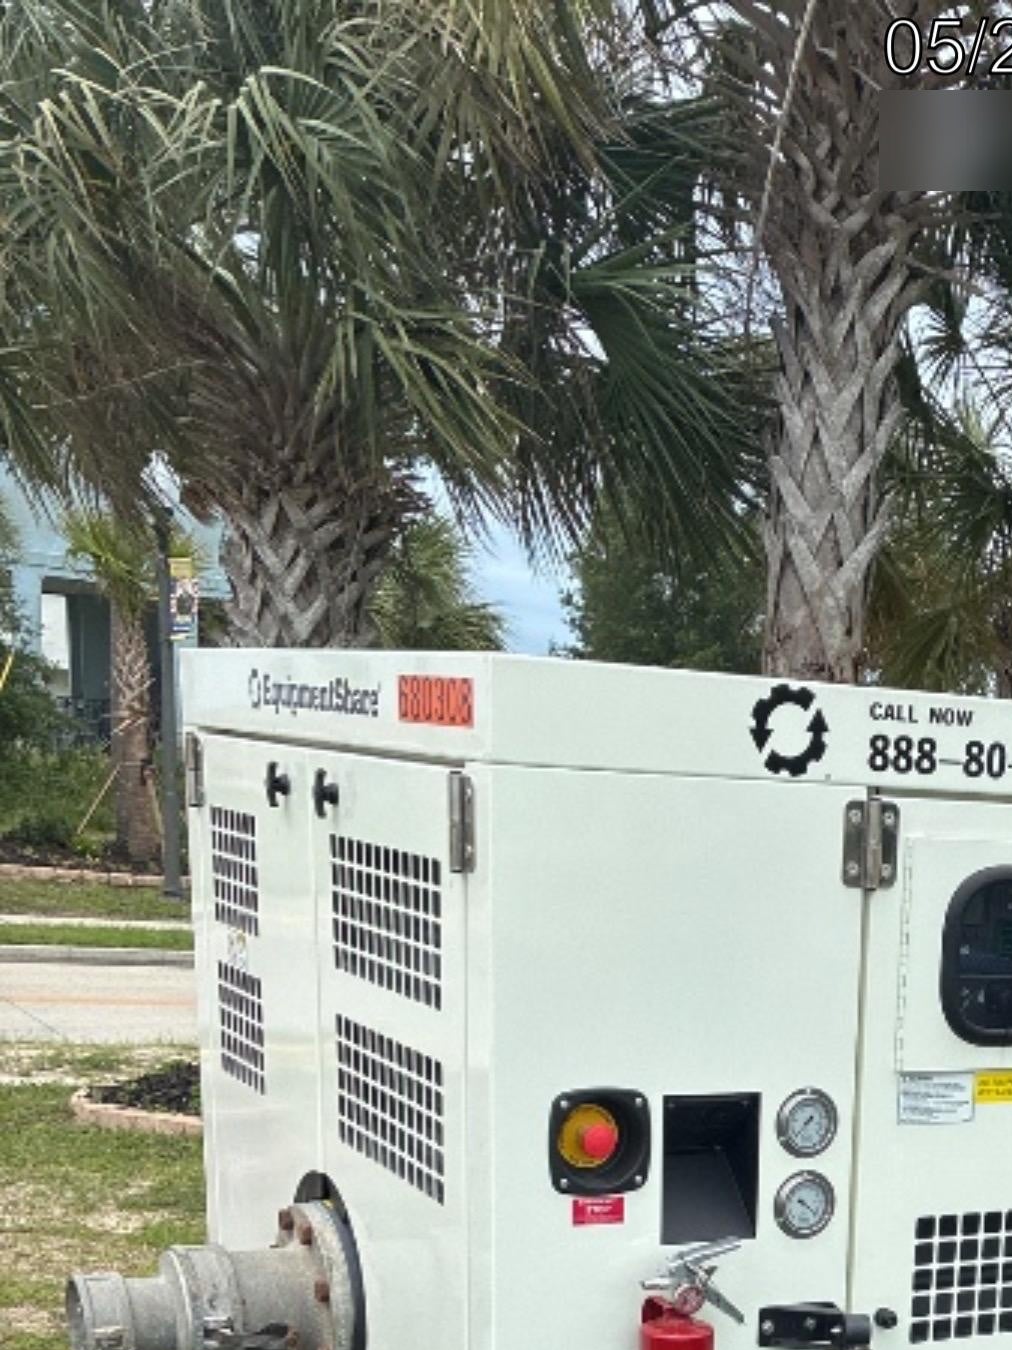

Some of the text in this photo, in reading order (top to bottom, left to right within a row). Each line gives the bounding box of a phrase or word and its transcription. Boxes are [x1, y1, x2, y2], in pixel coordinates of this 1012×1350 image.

[263, 674, 379, 717] EquipmentShare
[869, 701, 974, 727] CALL NOW
